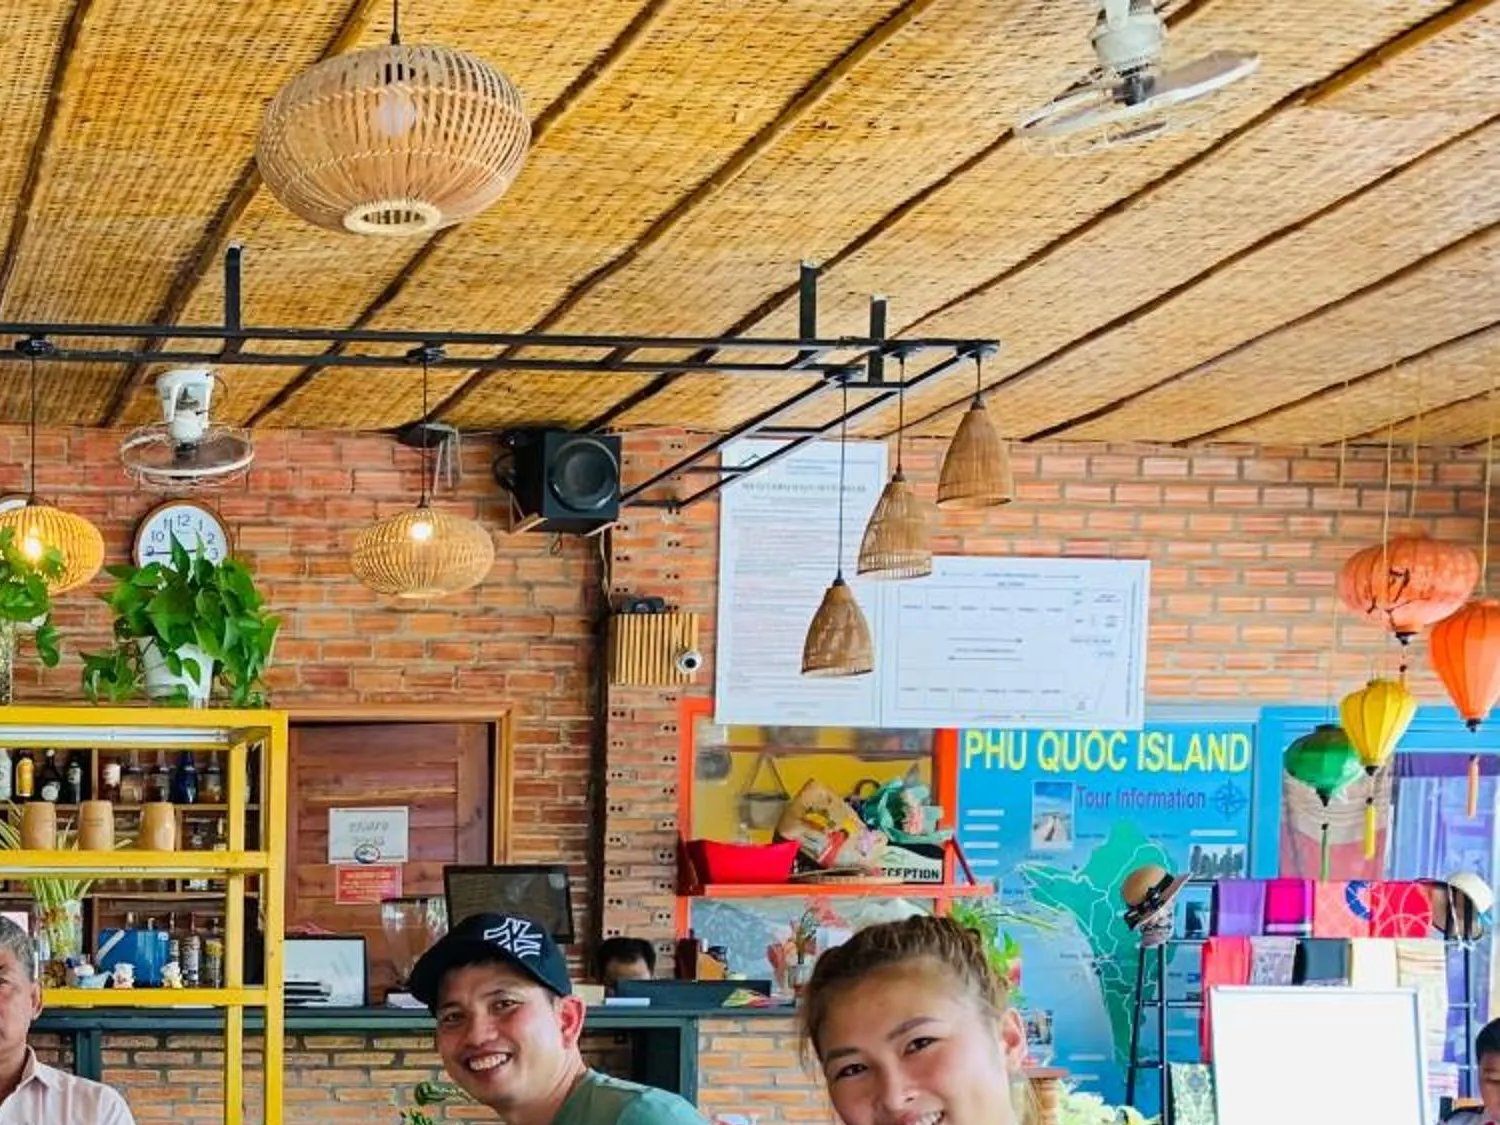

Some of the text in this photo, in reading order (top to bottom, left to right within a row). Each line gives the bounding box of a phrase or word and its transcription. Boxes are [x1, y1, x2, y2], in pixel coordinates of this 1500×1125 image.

[177, 513, 191, 527] 12
[151, 529, 165, 543] 10
[965, 729, 1028, 771] PHU
[1137, 732, 1250, 772] ISLAND
[1076, 786, 1205, 809] Tour Information
